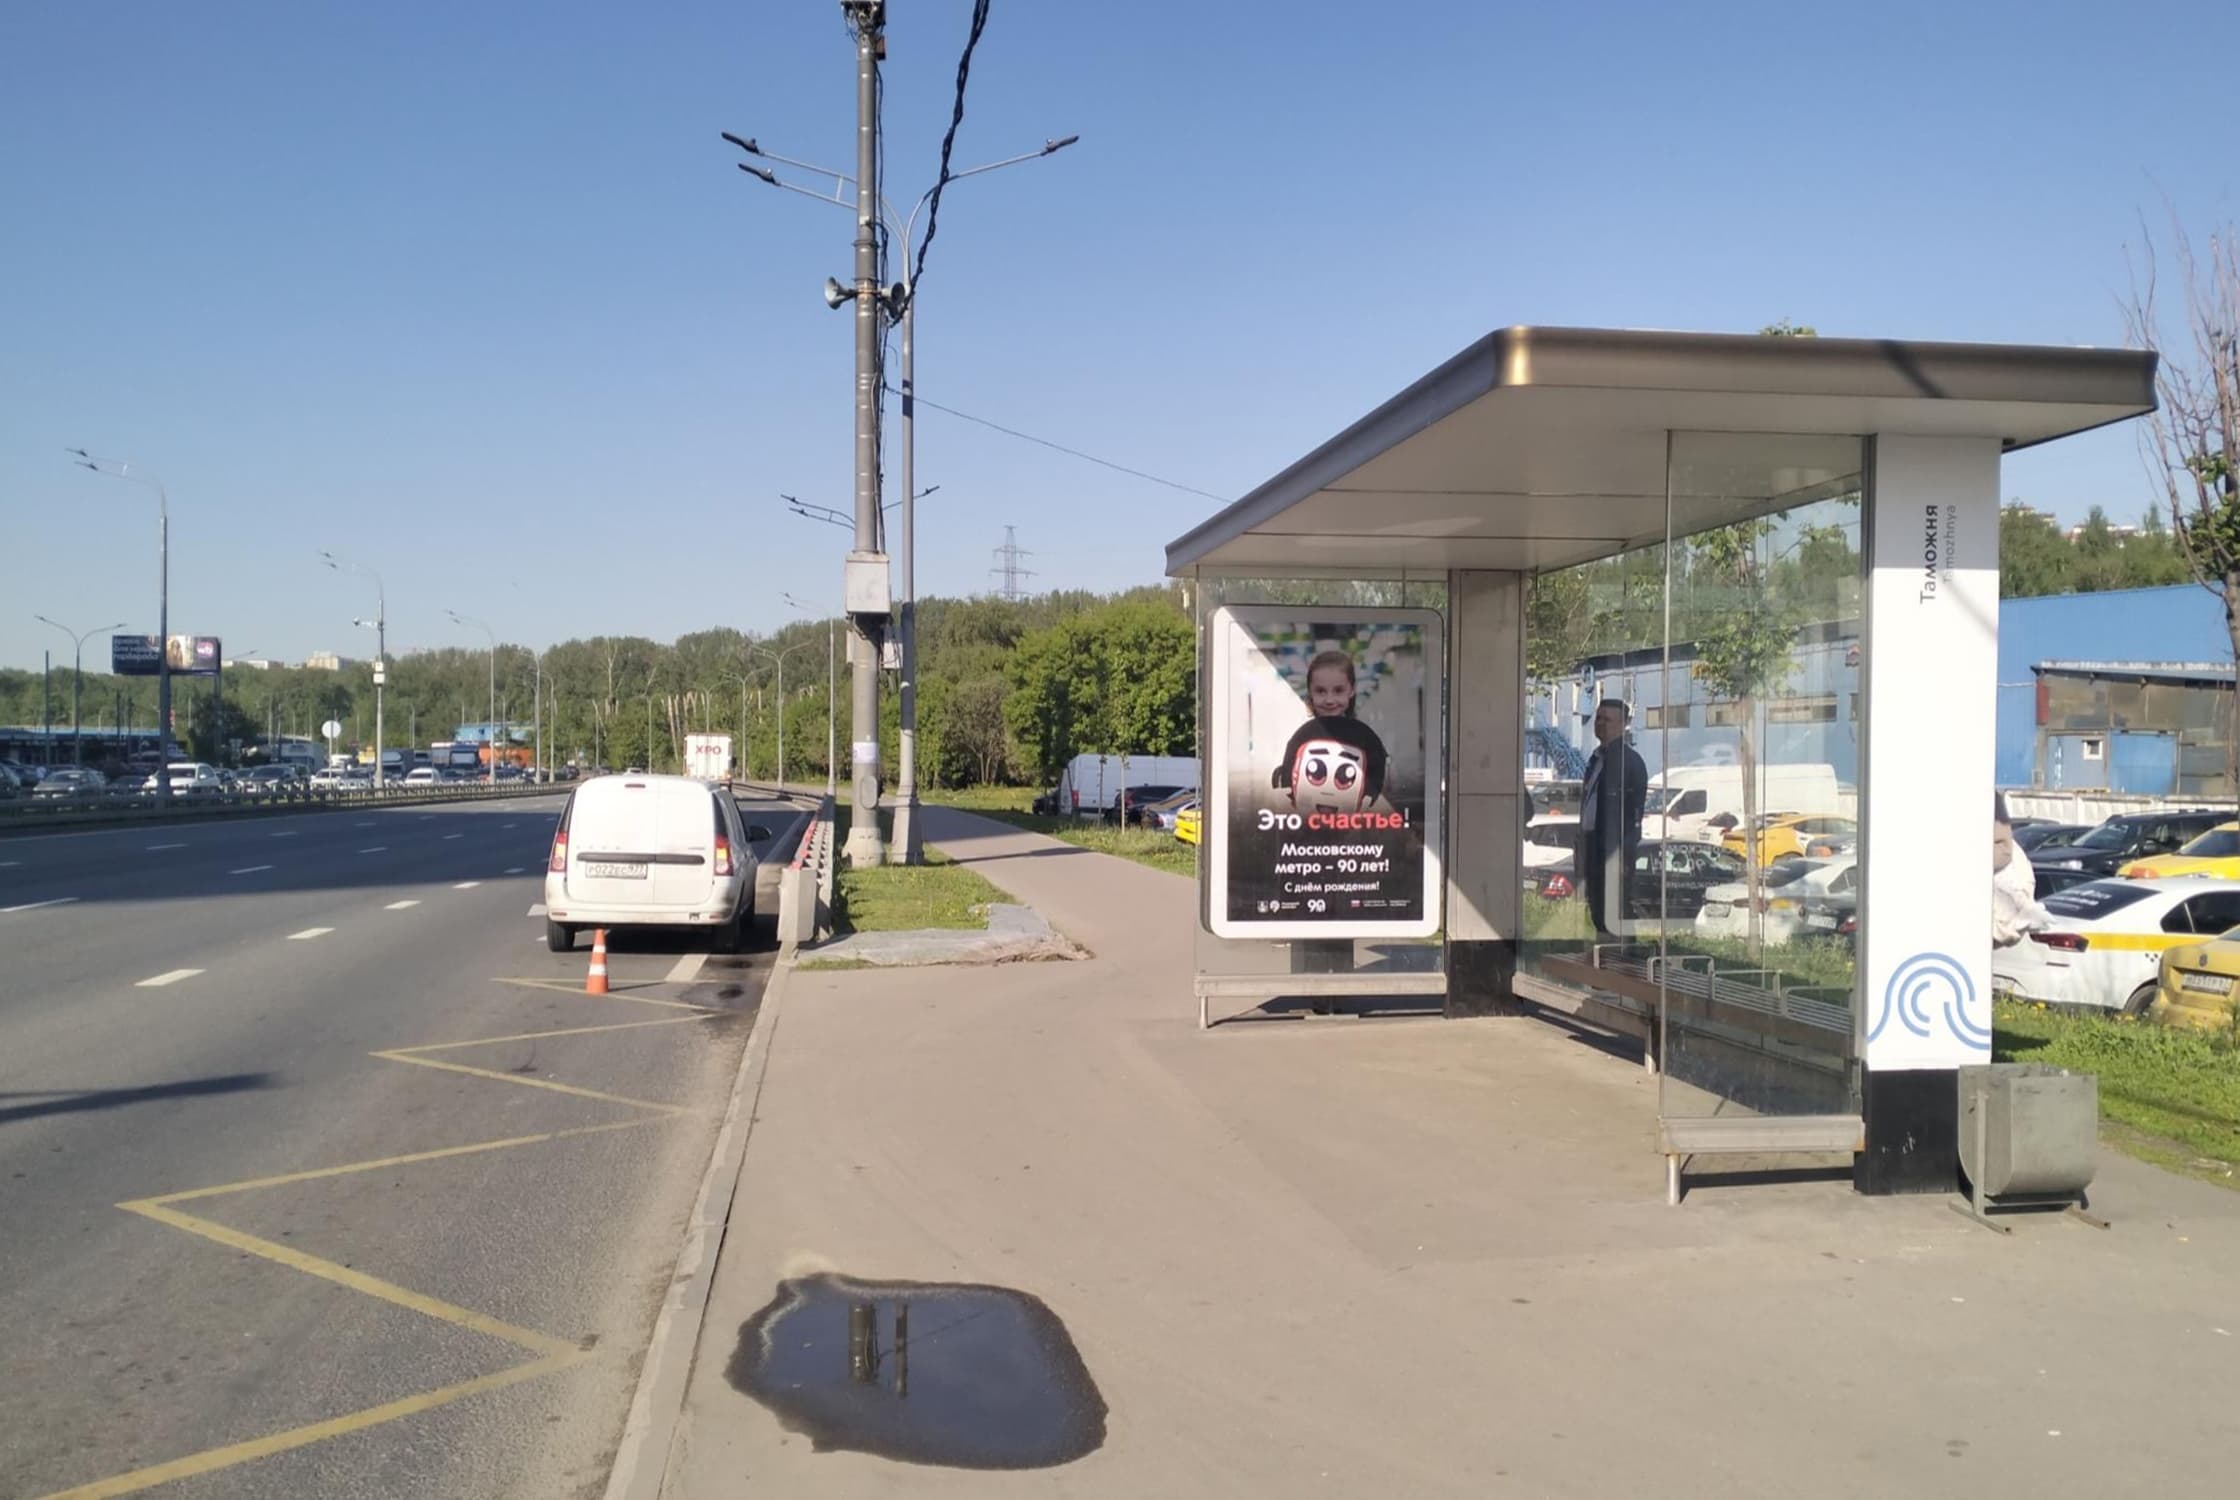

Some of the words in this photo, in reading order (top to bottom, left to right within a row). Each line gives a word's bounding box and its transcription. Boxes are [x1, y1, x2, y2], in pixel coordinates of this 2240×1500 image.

[1920, 505, 1938, 604] Таможня
[1257, 809, 1302, 830] Это
[1307, 808, 1411, 830] счастье!
[1281, 843, 1384, 857] Московскому
[1275, 862, 1322, 876] метро
[1337, 859, 1358, 873] 90
[1360, 858, 1390, 873] лет!
[1284, 882, 1293, 893] С
[1294, 881, 1322, 893] днём
[1324, 881, 1380, 893] рождения!
